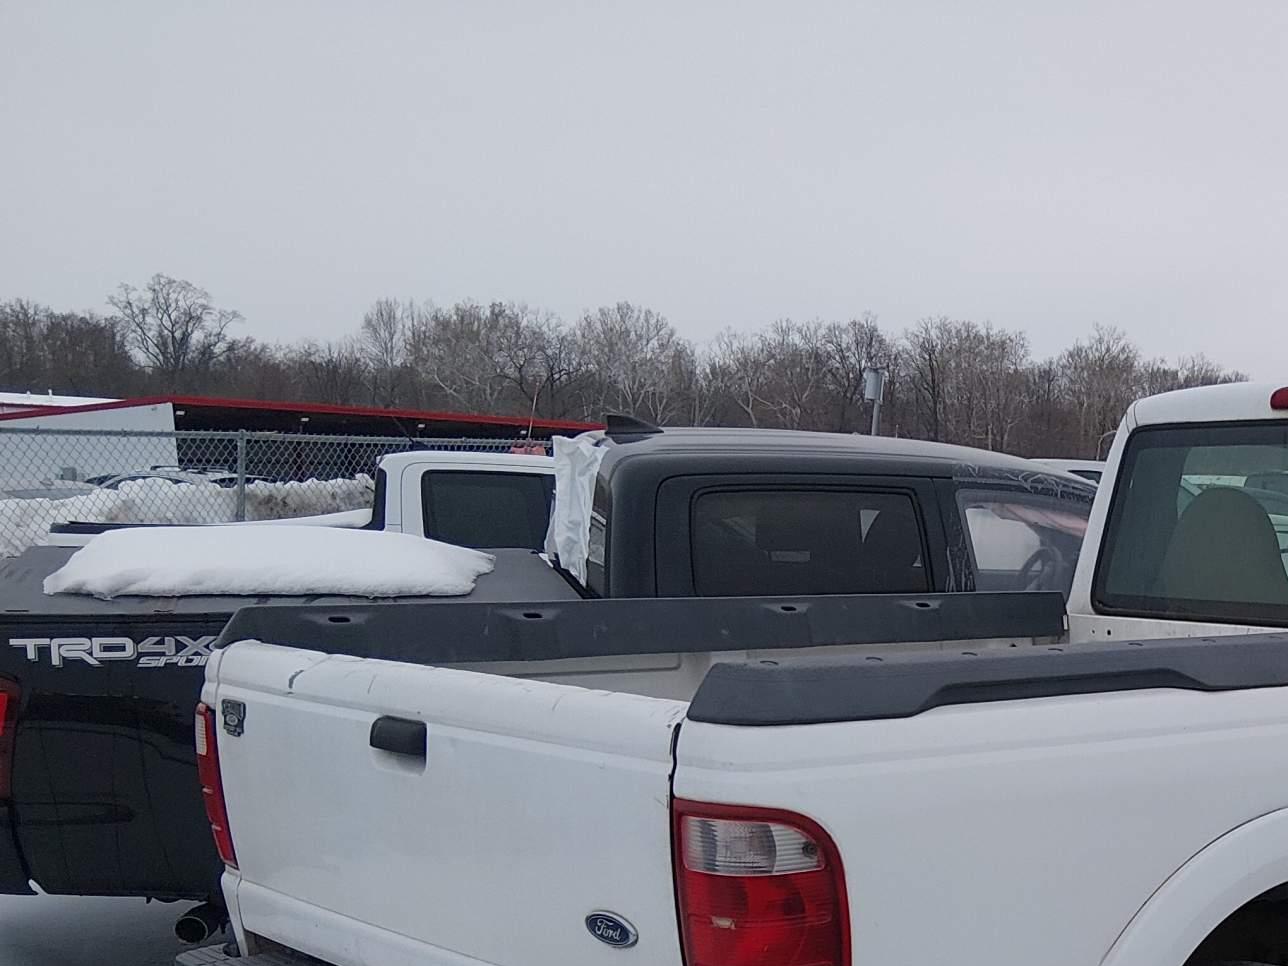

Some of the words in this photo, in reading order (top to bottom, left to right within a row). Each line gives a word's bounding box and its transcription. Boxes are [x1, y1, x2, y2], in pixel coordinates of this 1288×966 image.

[9, 637, 137, 668] TRD
[137, 635, 217, 656] 4X
[595, 918, 622, 941] Ford
